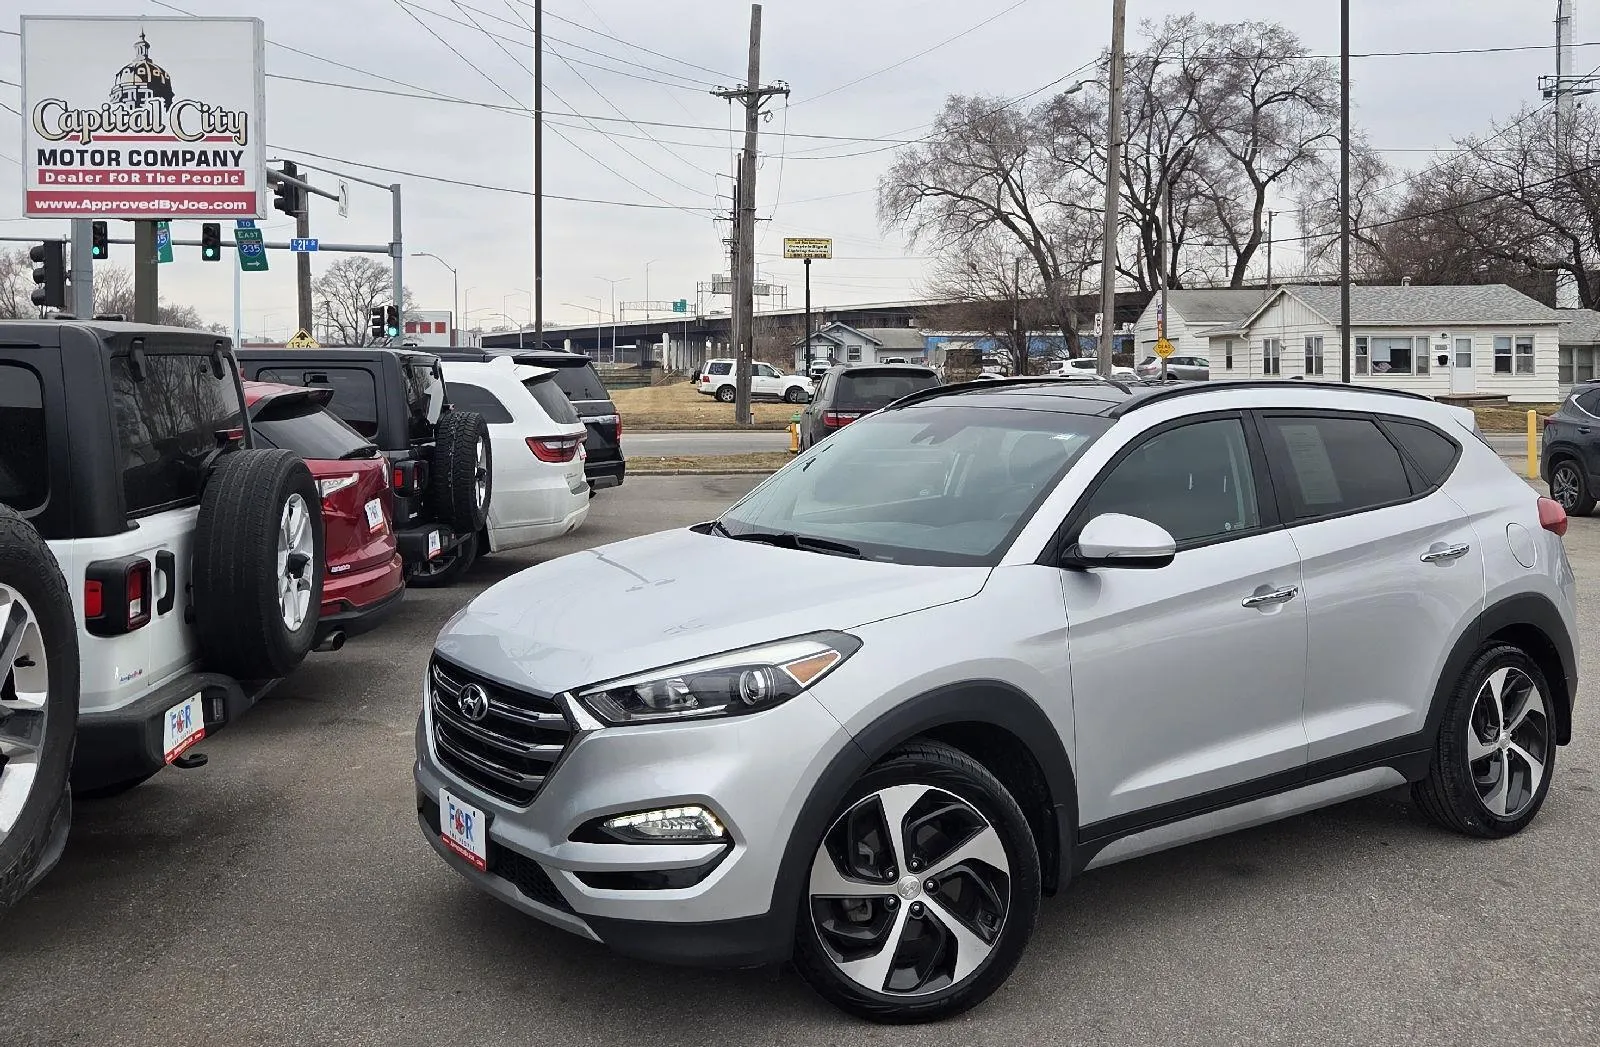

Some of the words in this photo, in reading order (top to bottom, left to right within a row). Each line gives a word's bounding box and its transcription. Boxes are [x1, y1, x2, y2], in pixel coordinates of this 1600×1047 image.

[32, 97, 166, 146] Capital
[170, 98, 249, 146] City
[37, 148, 121, 167] MOTOR
[128, 149, 244, 168] COMPANY
[45, 172, 102, 183] Dealer
[109, 172, 140, 183] FOR
[146, 173, 176, 183] The
[181, 173, 239, 186] People
[35, 199, 247, 212] www.ApprovedByJoe.com
[237, 231, 258, 239] EAST
[242, 244, 261, 253] 235
